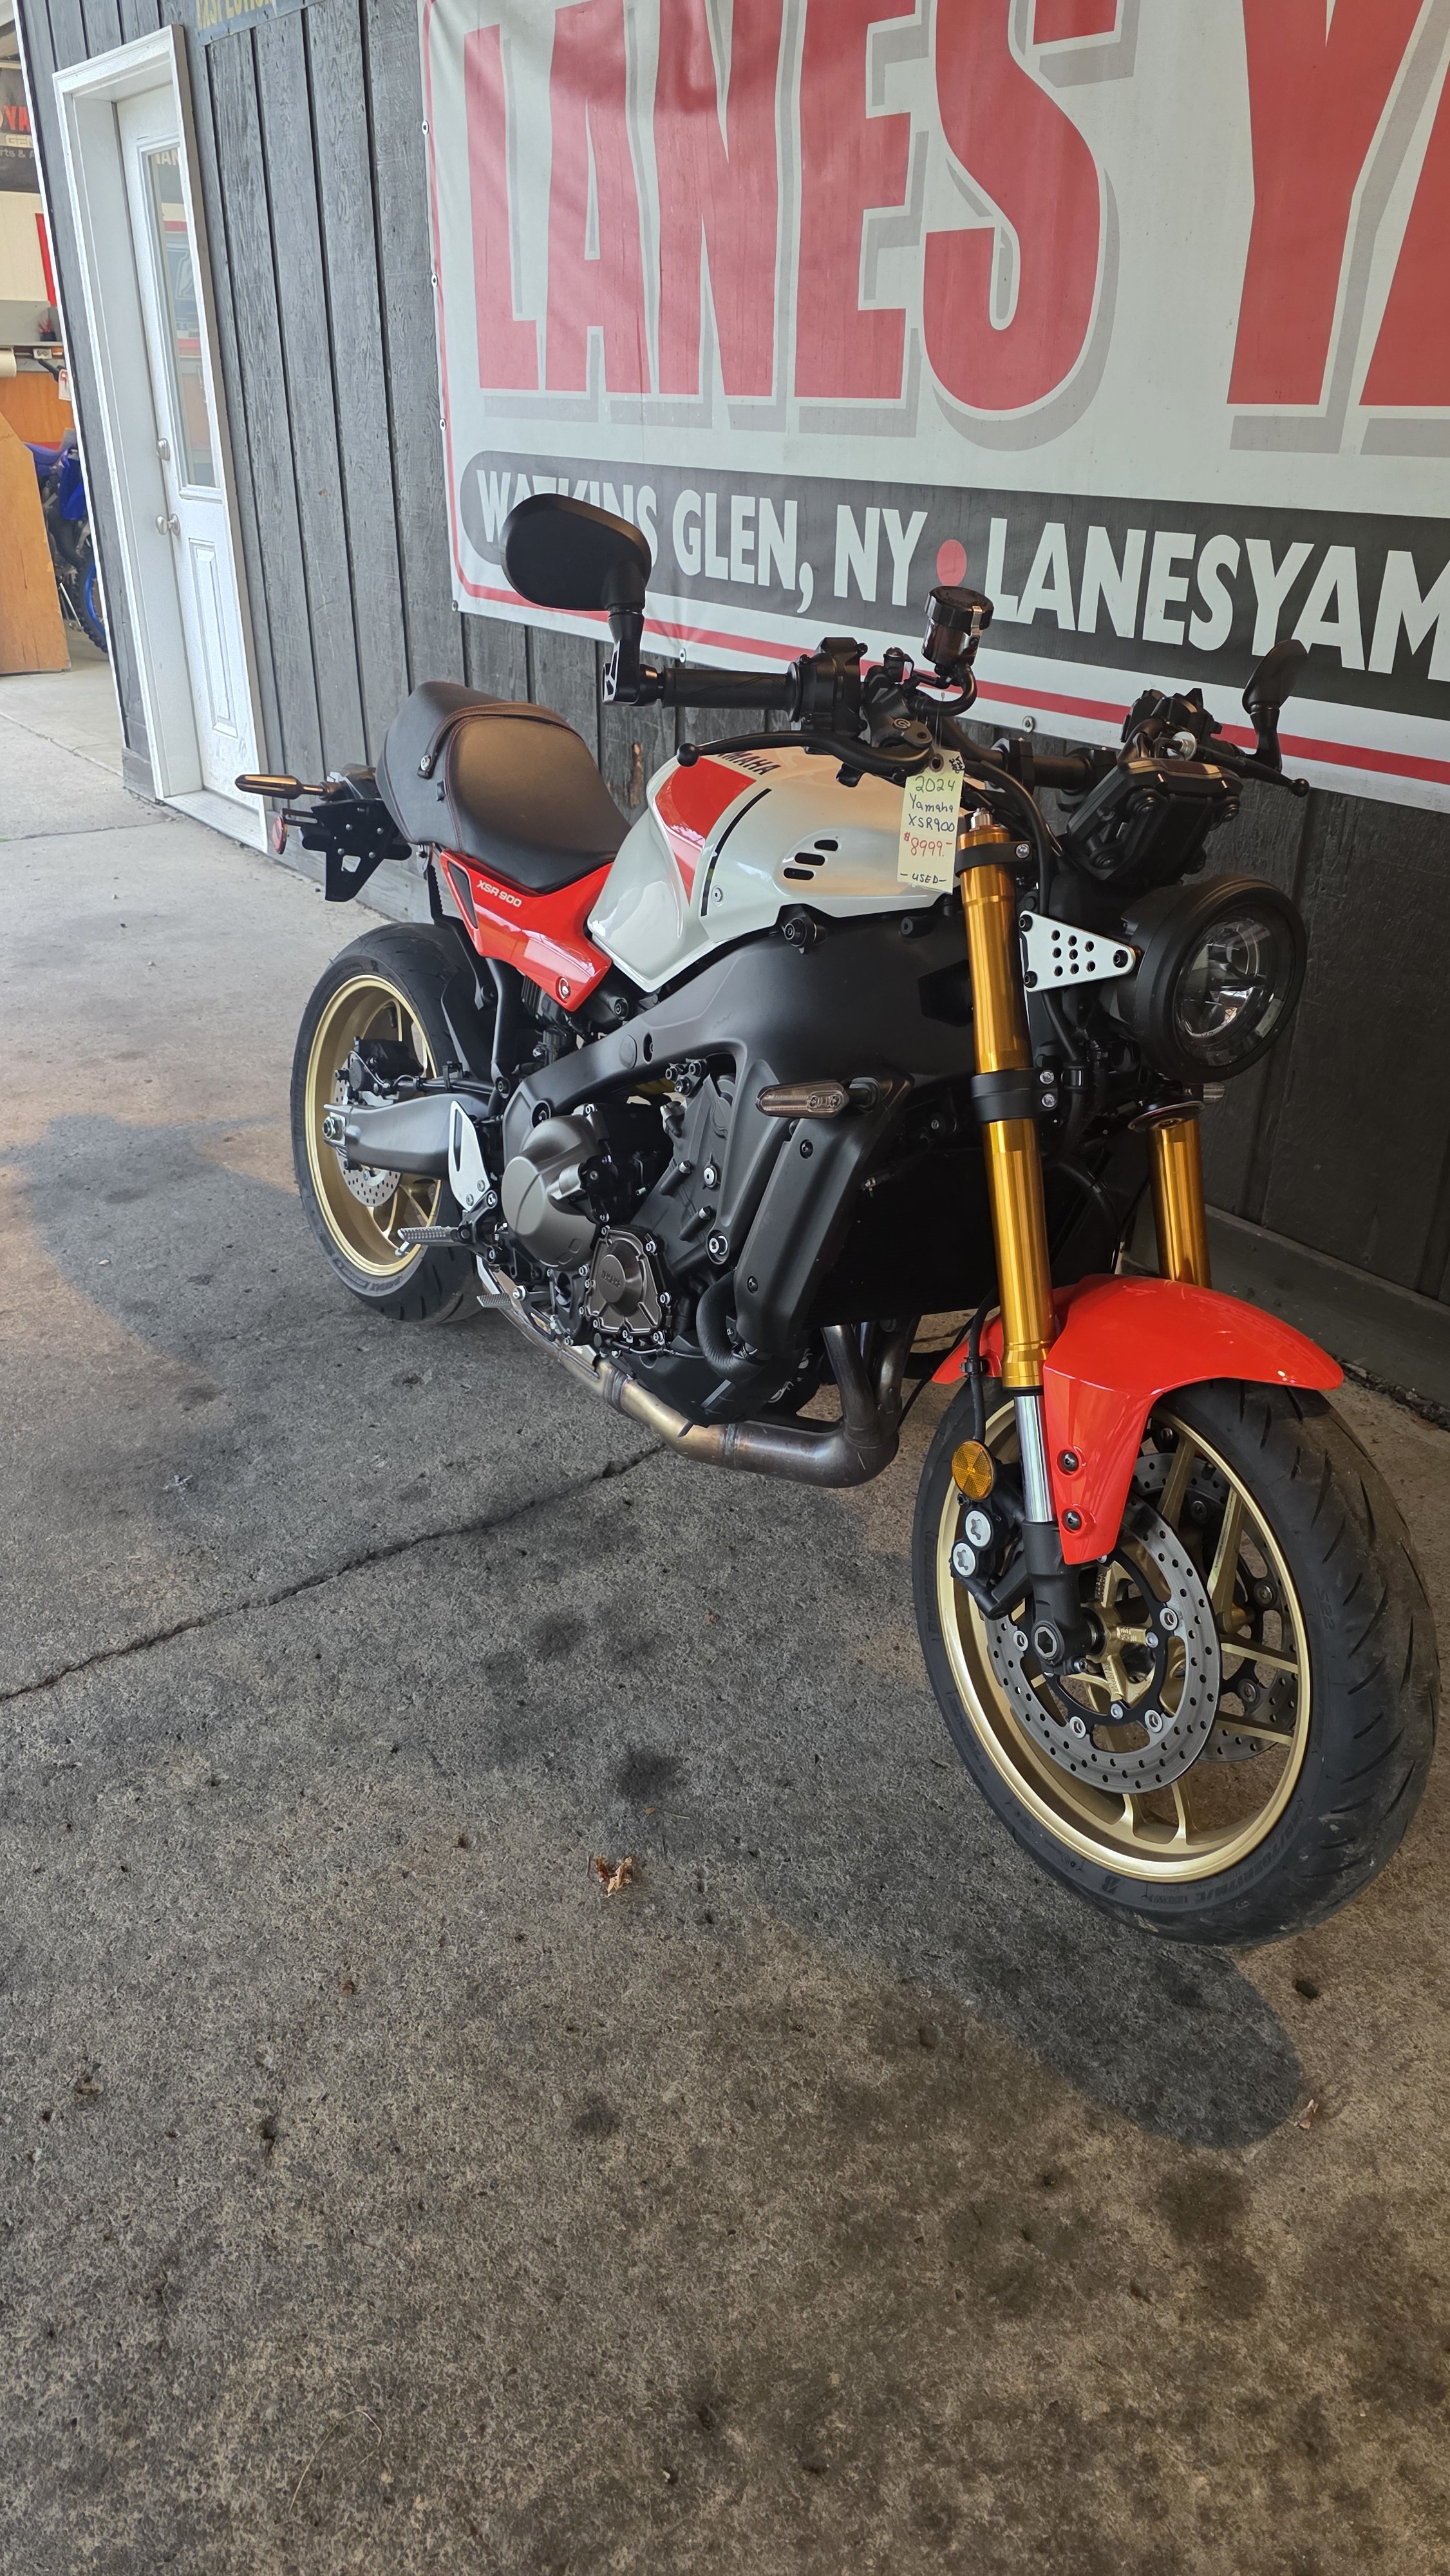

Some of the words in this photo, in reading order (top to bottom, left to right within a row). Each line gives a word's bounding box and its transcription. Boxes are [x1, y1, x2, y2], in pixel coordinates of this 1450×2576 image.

[464, 0, 1117, 411] LANES
[673, 489, 814, 613] GLEN,
[834, 505, 928, 606] NY
[985, 518, 1450, 682] LANESYAM
[915, 775, 956, 793] 2024
[909, 793, 954, 813] Yamaha
[908, 814, 955, 832] XSR900
[476, 880, 500, 897] XSR
[498, 891, 522, 908] 900
[1317, 1587, 1335, 1631] S22
